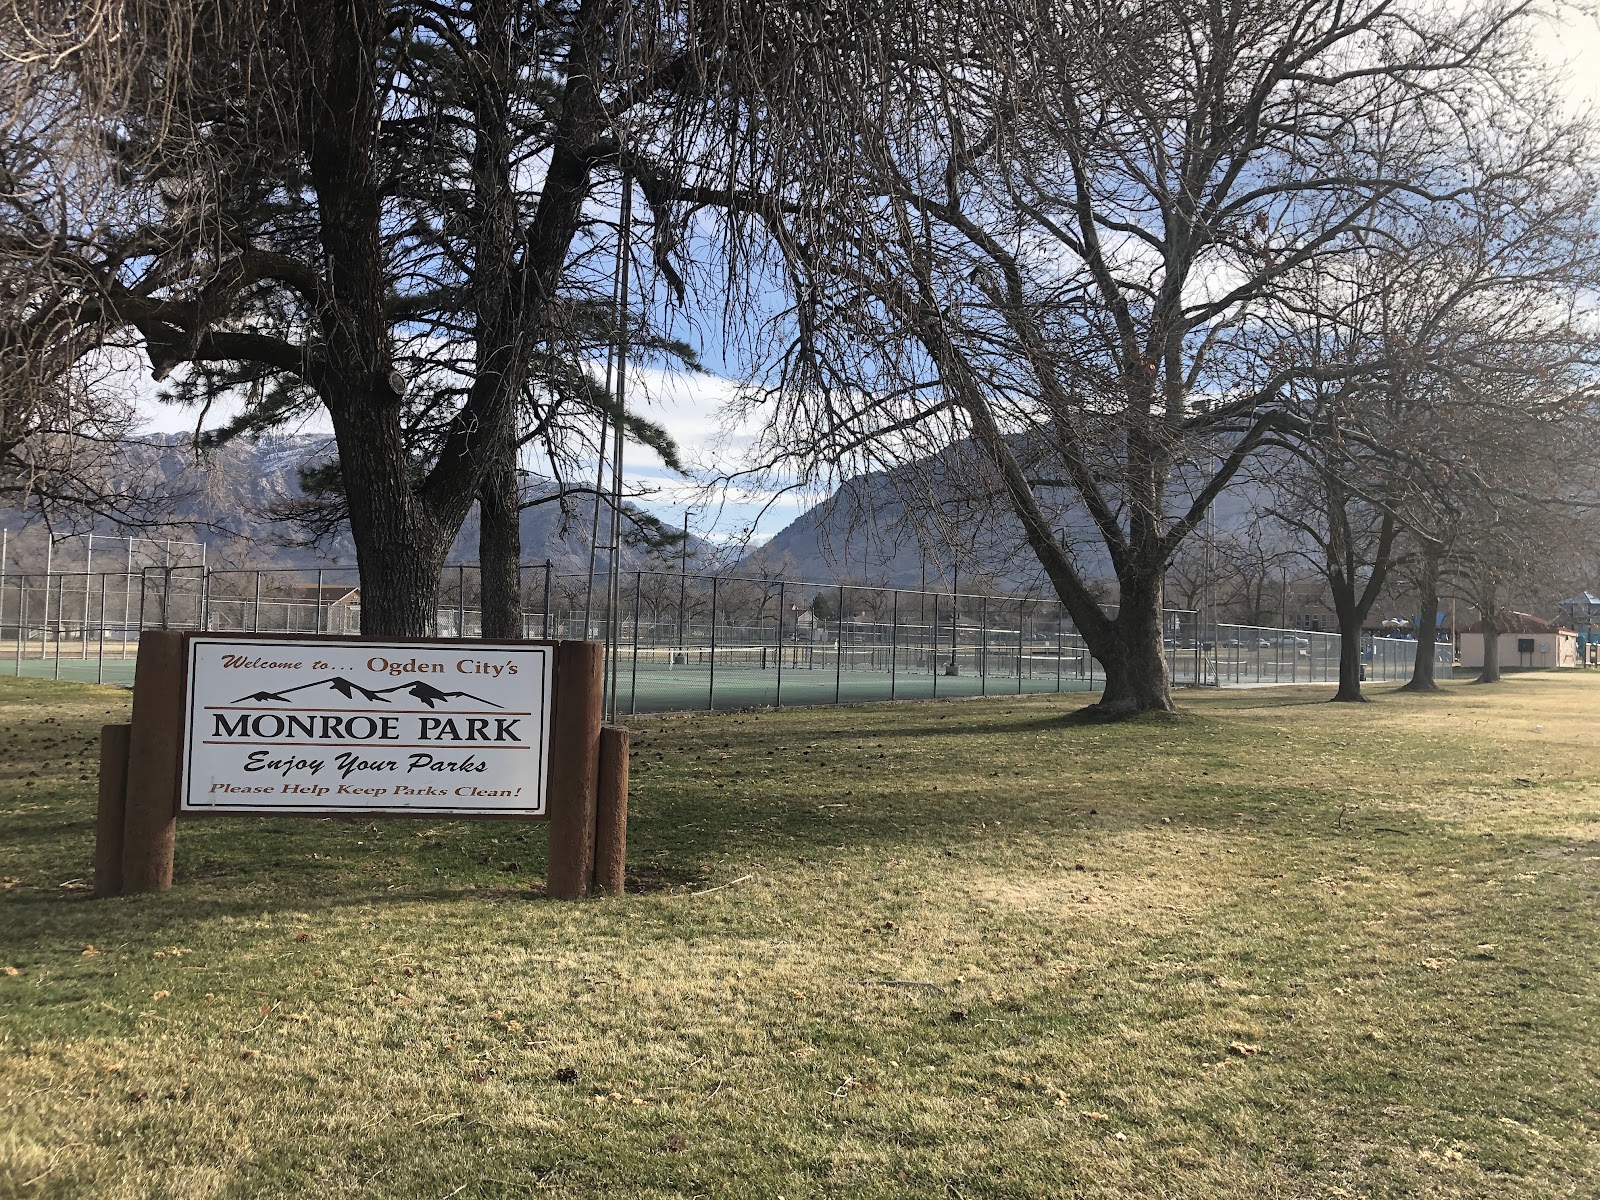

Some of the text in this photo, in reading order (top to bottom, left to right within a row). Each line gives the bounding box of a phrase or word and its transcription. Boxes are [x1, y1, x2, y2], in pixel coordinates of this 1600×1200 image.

[221, 654, 303, 670] Welcome
[366, 657, 446, 676] Ogden
[456, 659, 519, 678] City's
[211, 713, 522, 742] MONROE PARK
[243, 751, 489, 779] Enjoy Your Parks
[208, 783, 522, 798] Please Help Keep Parks Clean!
